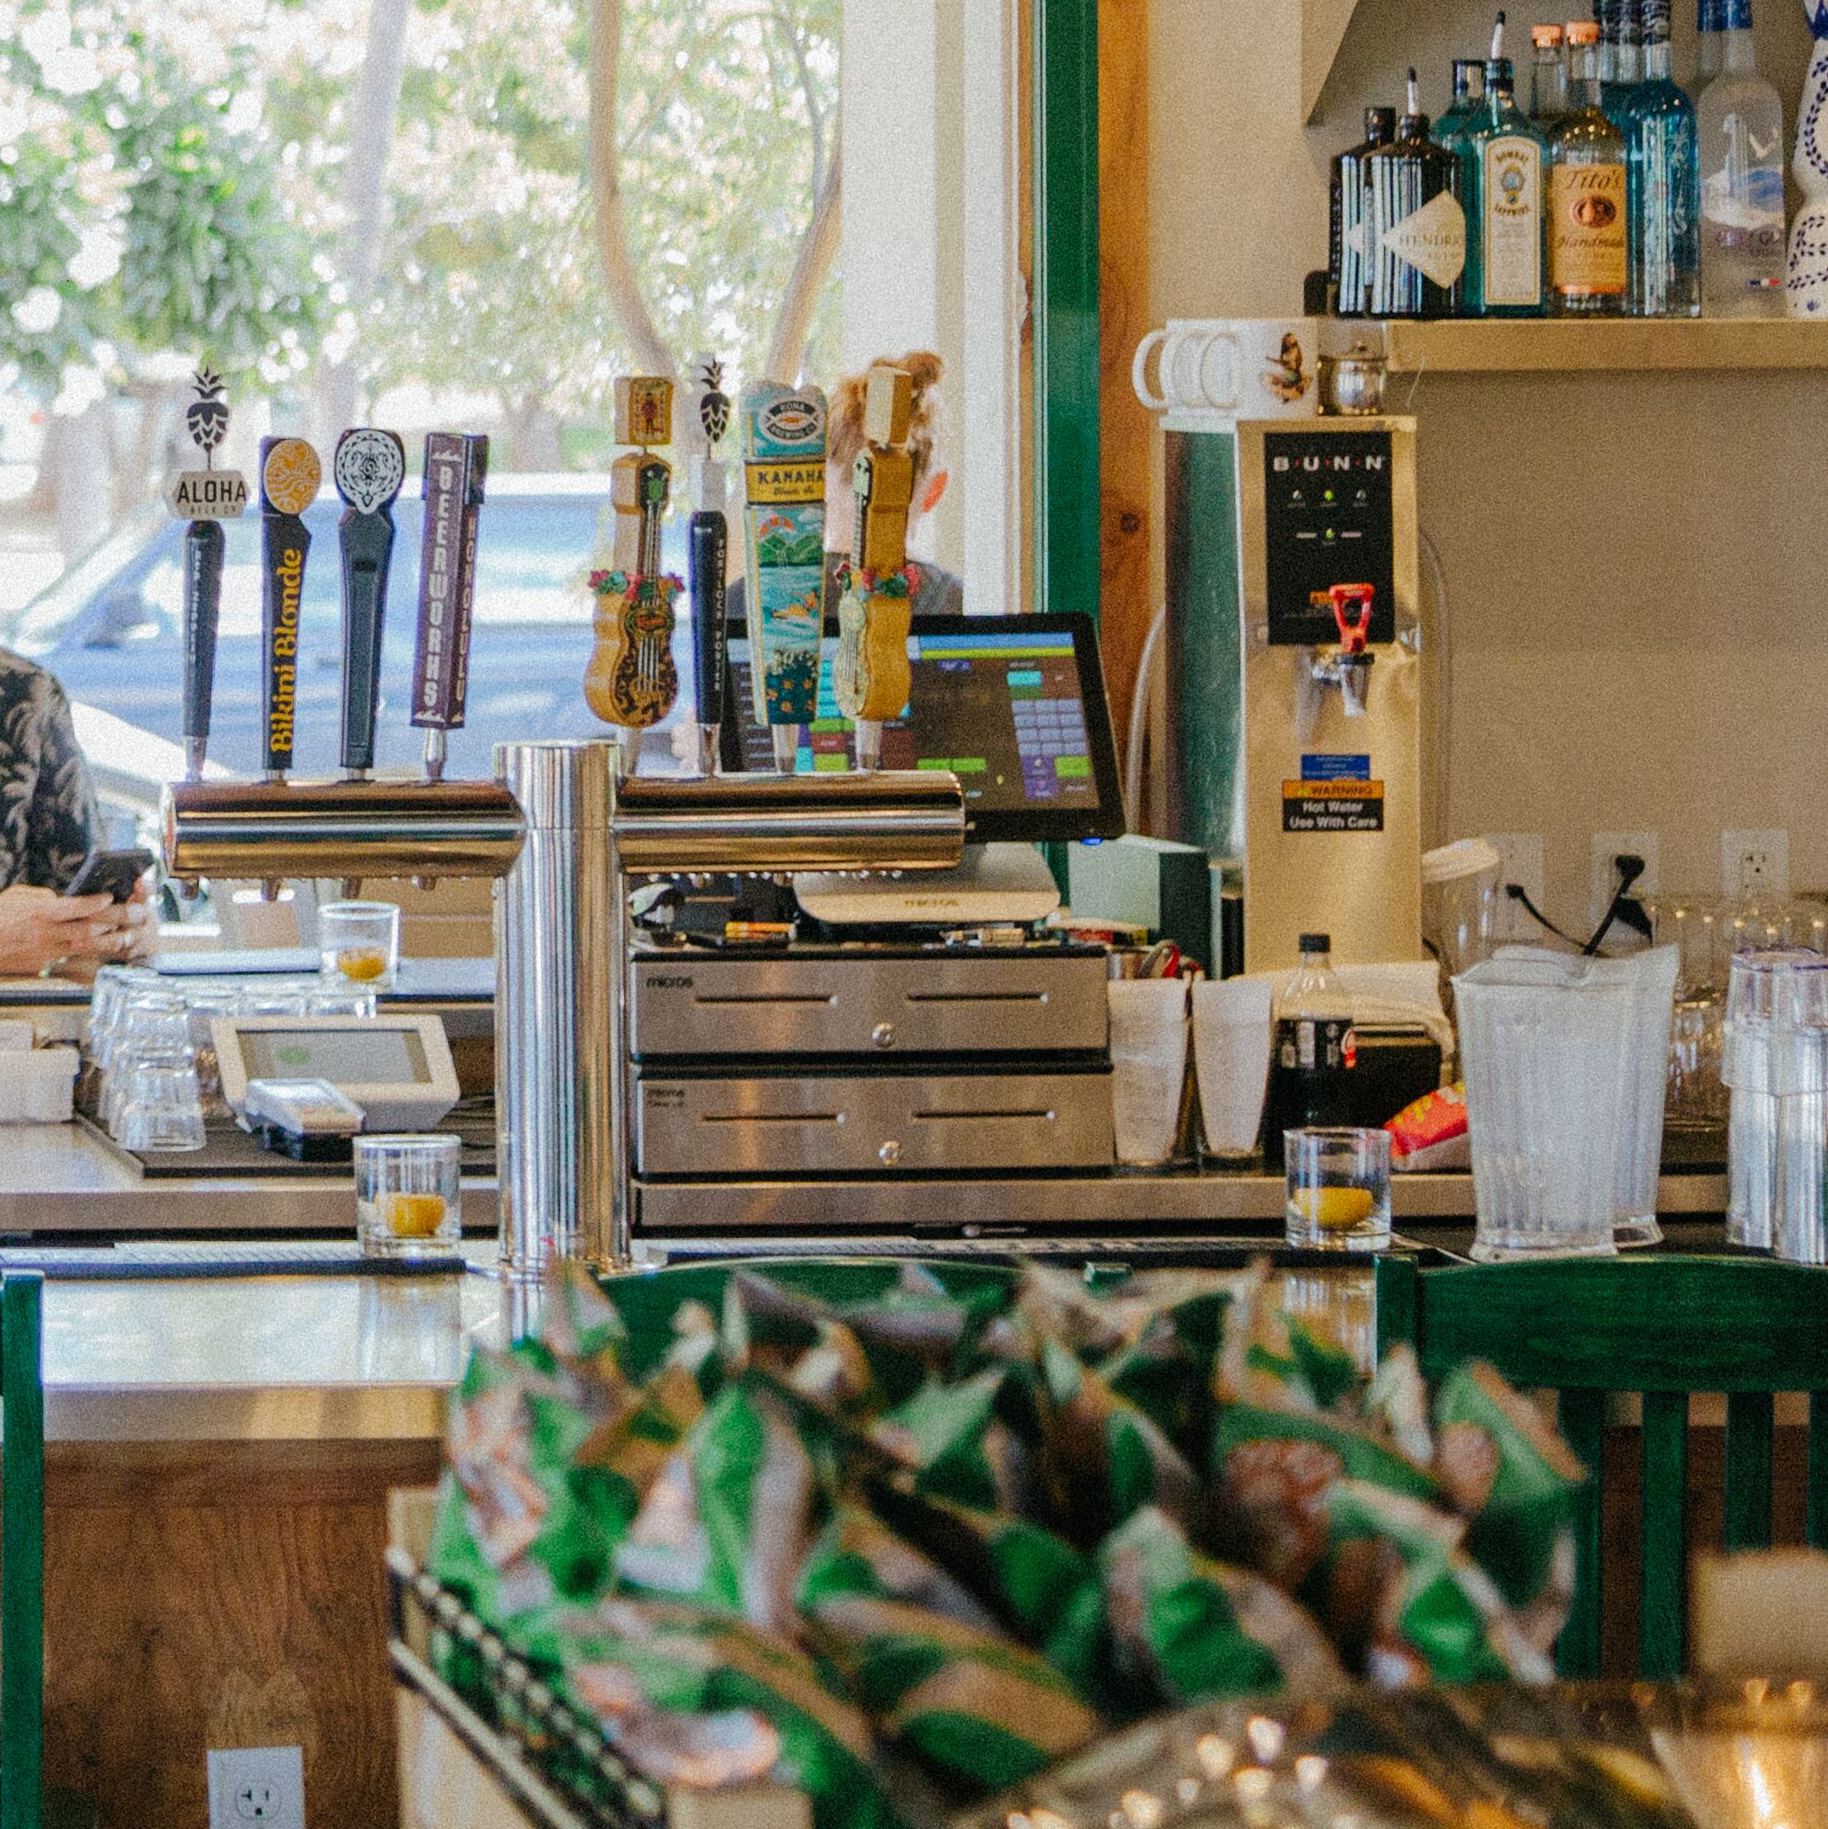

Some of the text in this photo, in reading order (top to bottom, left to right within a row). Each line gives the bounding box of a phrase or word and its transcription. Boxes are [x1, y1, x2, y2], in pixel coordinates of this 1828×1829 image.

[176, 480, 247, 504] ALOHA
[423, 465, 453, 707] BEERWORKS
[456, 516, 477, 702] HONOLULU
[713, 538, 725, 692] PORTLOCK PORTER
[270, 547, 303, 753] Bikini Blonde
[1309, 786, 1373, 796] WARNING
[1303, 801, 1363, 813] Hot Water
[1289, 816, 1378, 829] Use With Care
[646, 975, 694, 989] micros
